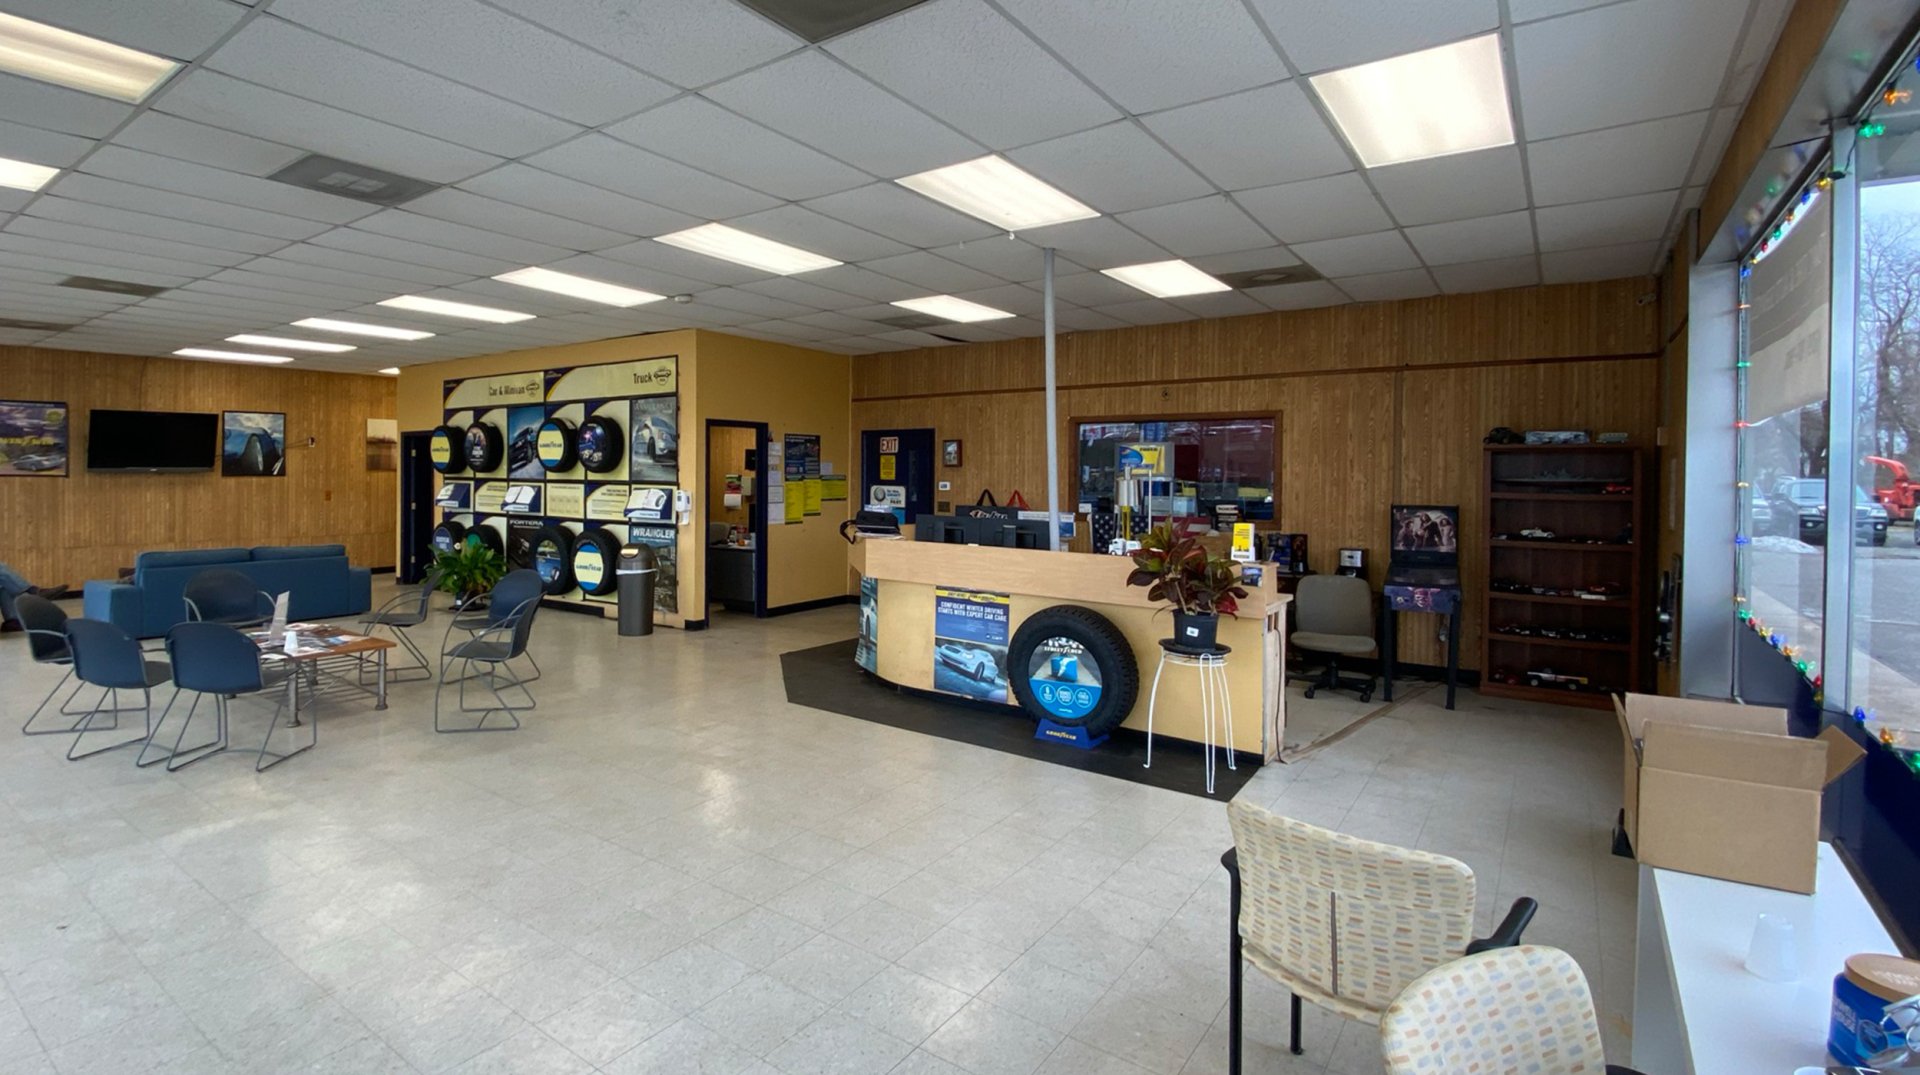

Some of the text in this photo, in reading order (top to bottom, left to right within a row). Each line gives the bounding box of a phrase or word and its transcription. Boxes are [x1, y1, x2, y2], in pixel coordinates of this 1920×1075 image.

[633, 372, 653, 385] Truck
[489, 386, 498, 397] Car
[881, 438, 898, 452] EXIT
[633, 527, 675, 539] WRANGLER
[938, 606, 953, 615] STARTS
[954, 609, 966, 617] WITH
[966, 611, 984, 619] EXPERT
[994, 614, 1007, 622] CARE
[941, 601, 1004, 615] CONFIDENT WINTER DRIVING
